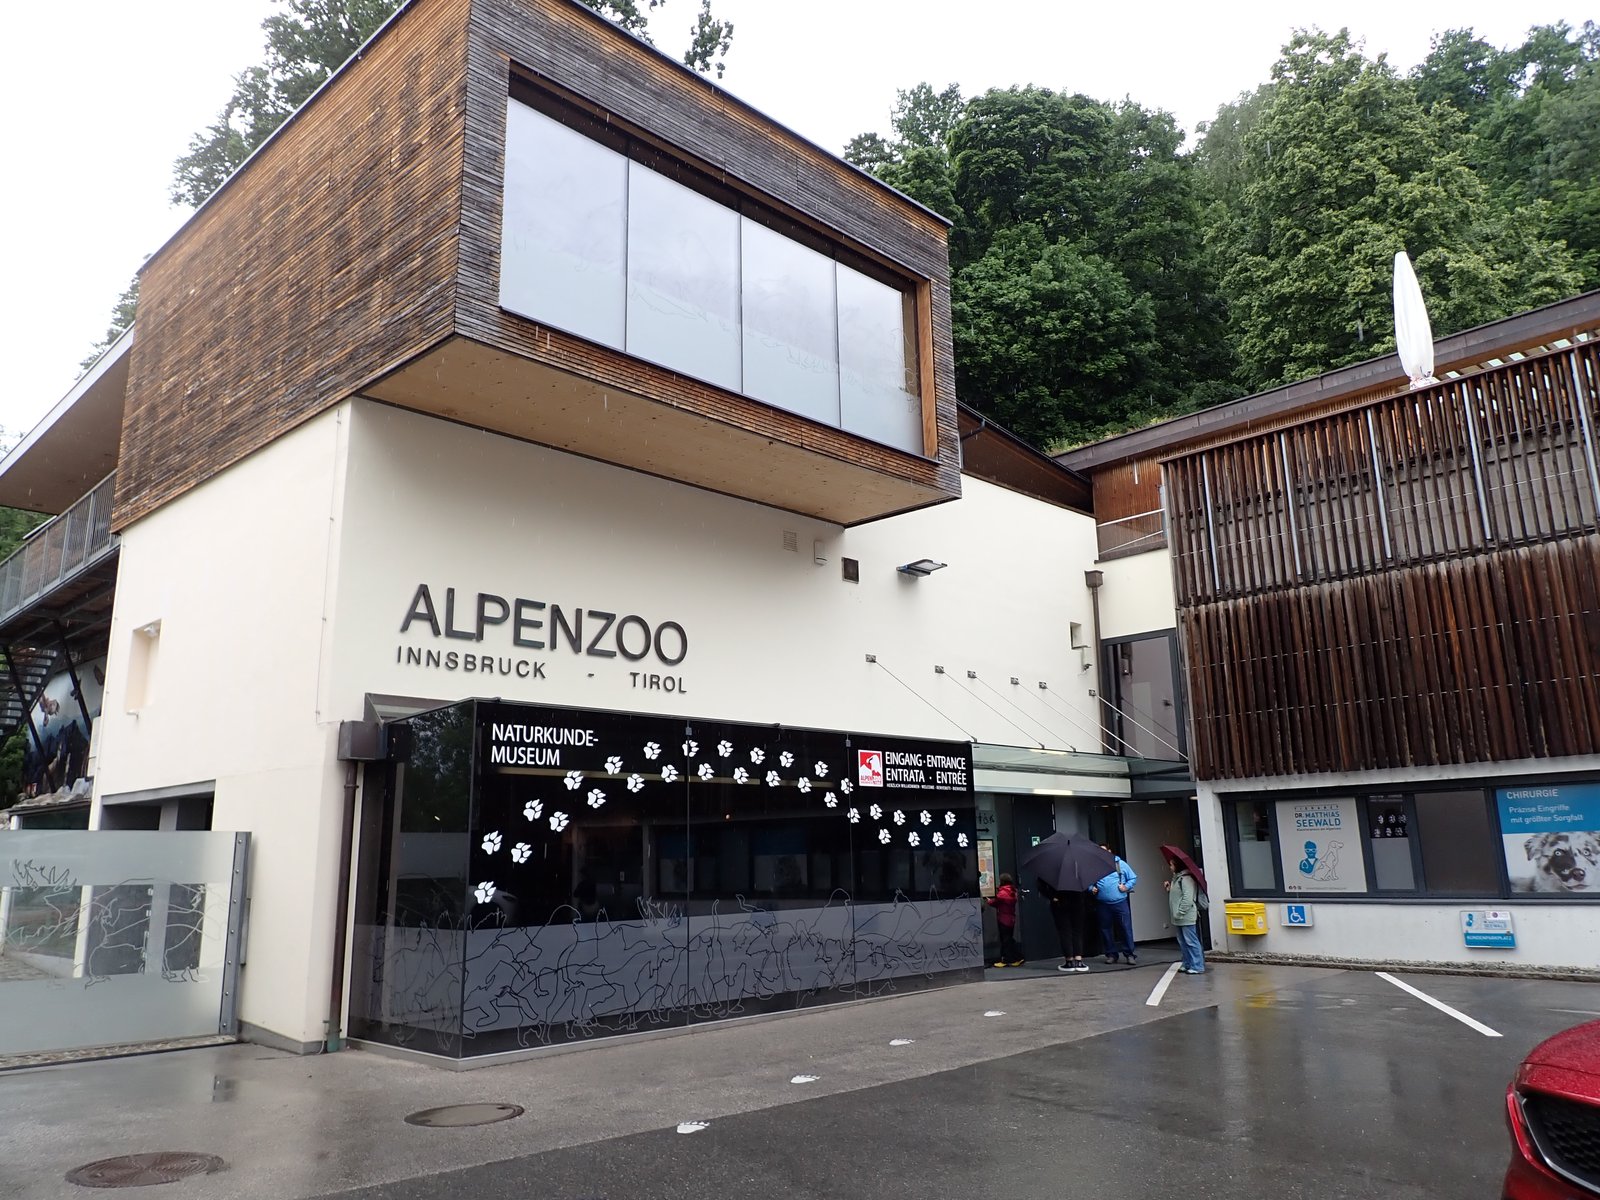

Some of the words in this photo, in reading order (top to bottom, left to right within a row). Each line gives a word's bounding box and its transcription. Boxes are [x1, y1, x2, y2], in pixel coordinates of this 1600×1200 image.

[400, 583, 688, 666] ALPENZOO
[397, 645, 546, 679] INNSBRUCK
[629, 671, 688, 693] TIROL
[492, 722, 599, 747] NATURKUNDE-
[491, 745, 560, 766] MUSEUM
[885, 751, 922, 767] EINGANG
[926, 754, 966, 770] ENTRANCE
[885, 768, 925, 783] ENTRATA
[936, 770, 968, 785] ENTRÉE
[1506, 788, 1559, 799] CHIRURGIE
[1508, 806, 1537, 814] Präzise
[1537, 804, 1570, 814] Eingriffe
[1296, 818, 1341, 828] SEEWALD
[1525, 815, 1552, 825] größter
[1553, 813, 1584, 823] Sorgfalt
